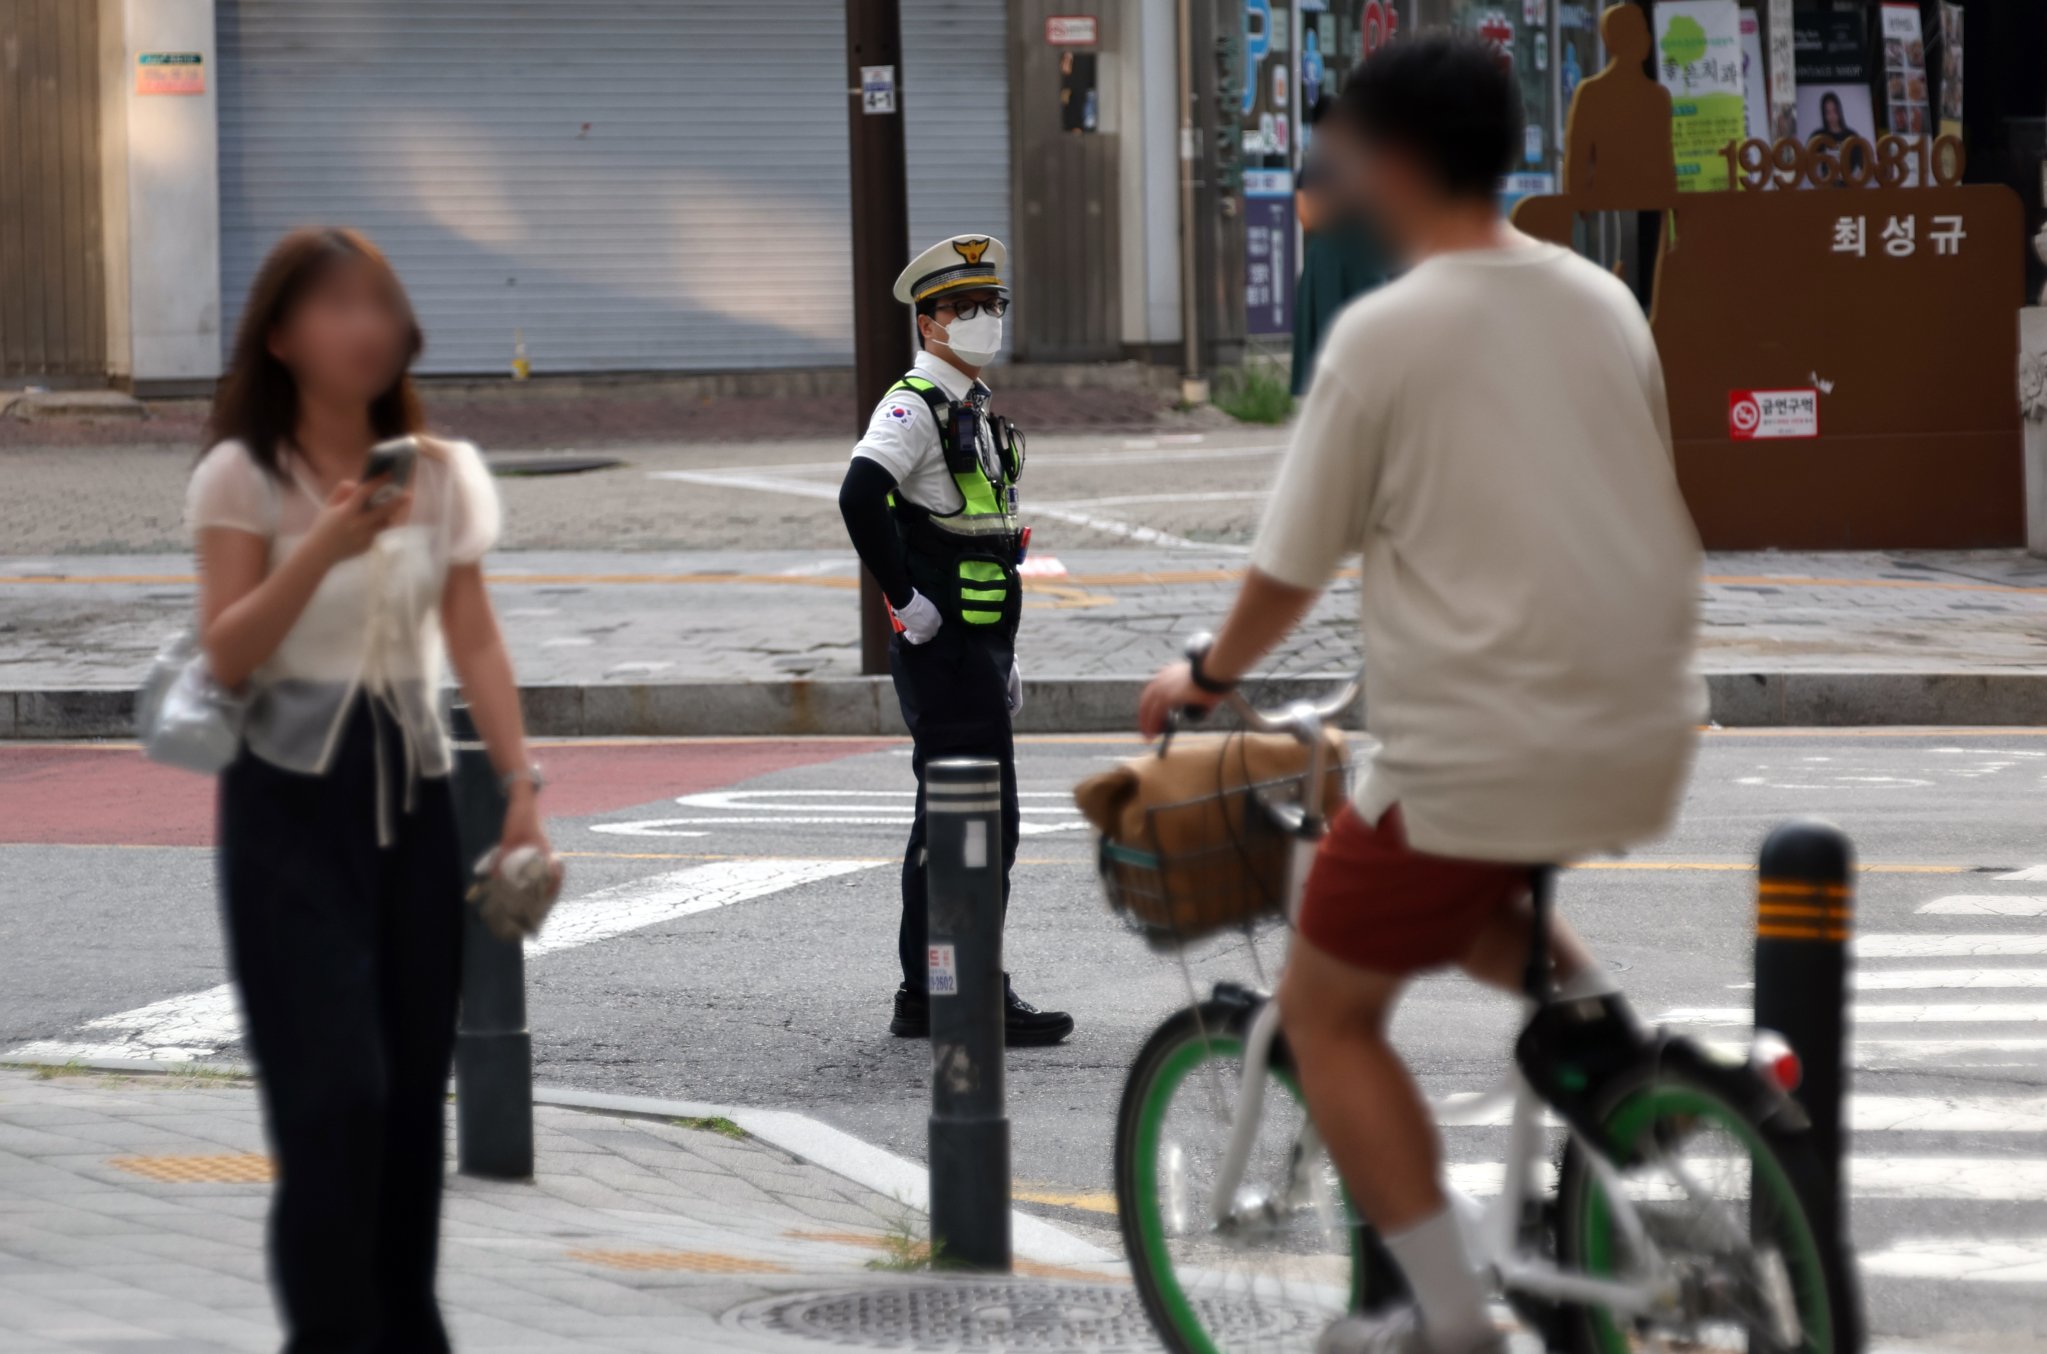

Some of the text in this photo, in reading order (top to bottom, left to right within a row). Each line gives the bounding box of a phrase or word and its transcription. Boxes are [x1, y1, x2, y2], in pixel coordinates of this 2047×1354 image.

[1719, 134, 1966, 191] 19960810
[1831, 214, 1967, 257] 최성규
[1761, 397, 1814, 416] 금연구역
